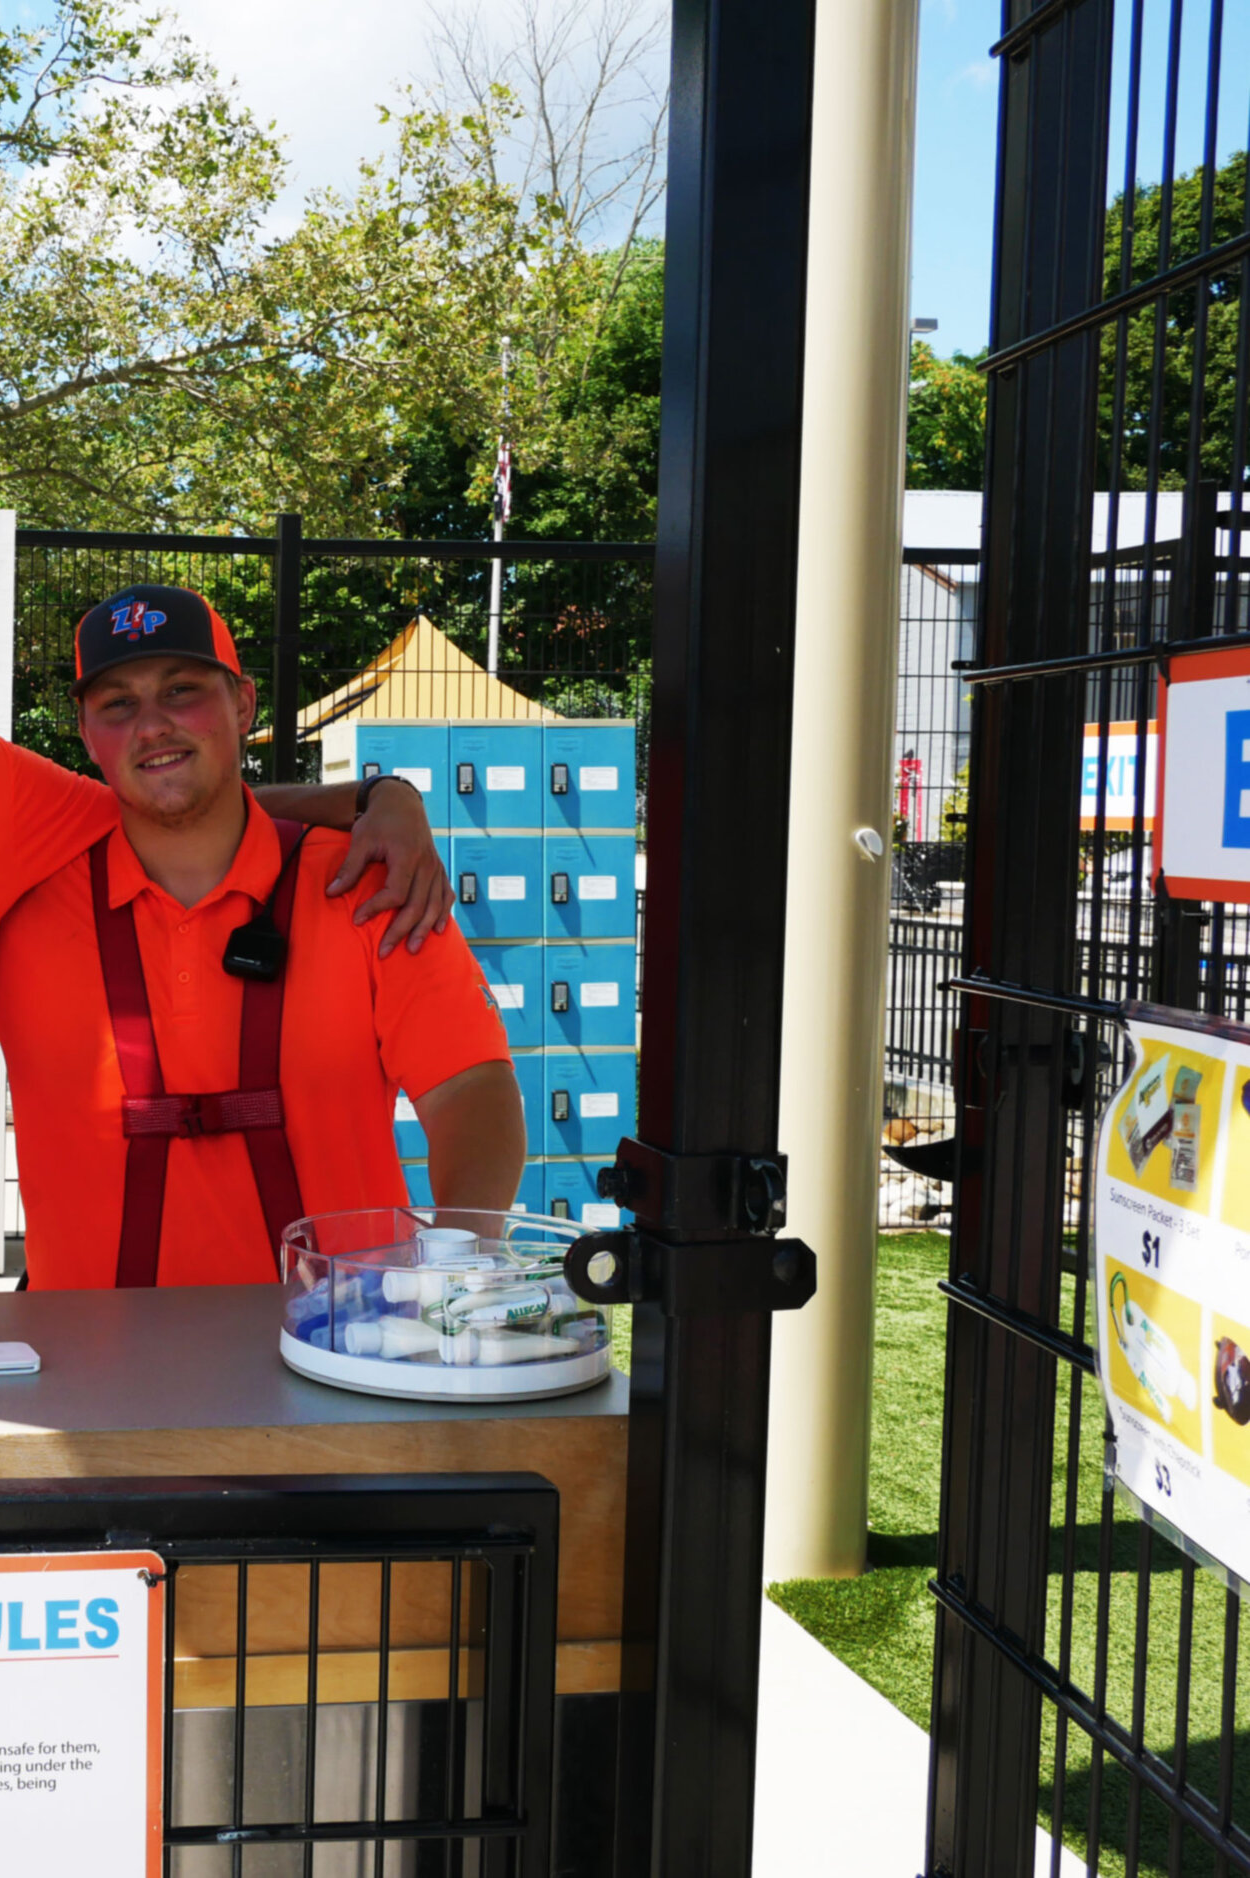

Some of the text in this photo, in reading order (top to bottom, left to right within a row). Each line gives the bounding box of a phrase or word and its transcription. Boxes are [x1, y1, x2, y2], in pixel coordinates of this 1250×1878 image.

[1142, 1230, 1160, 1268] $1
[1155, 1456, 1172, 1497] $3
[38, 1742, 56, 1754] for
[60, 1742, 100, 1753] them,
[25, 1759, 65, 1772] under
[69, 1758, 92, 1770] the
[16, 1778, 56, 1791] being
